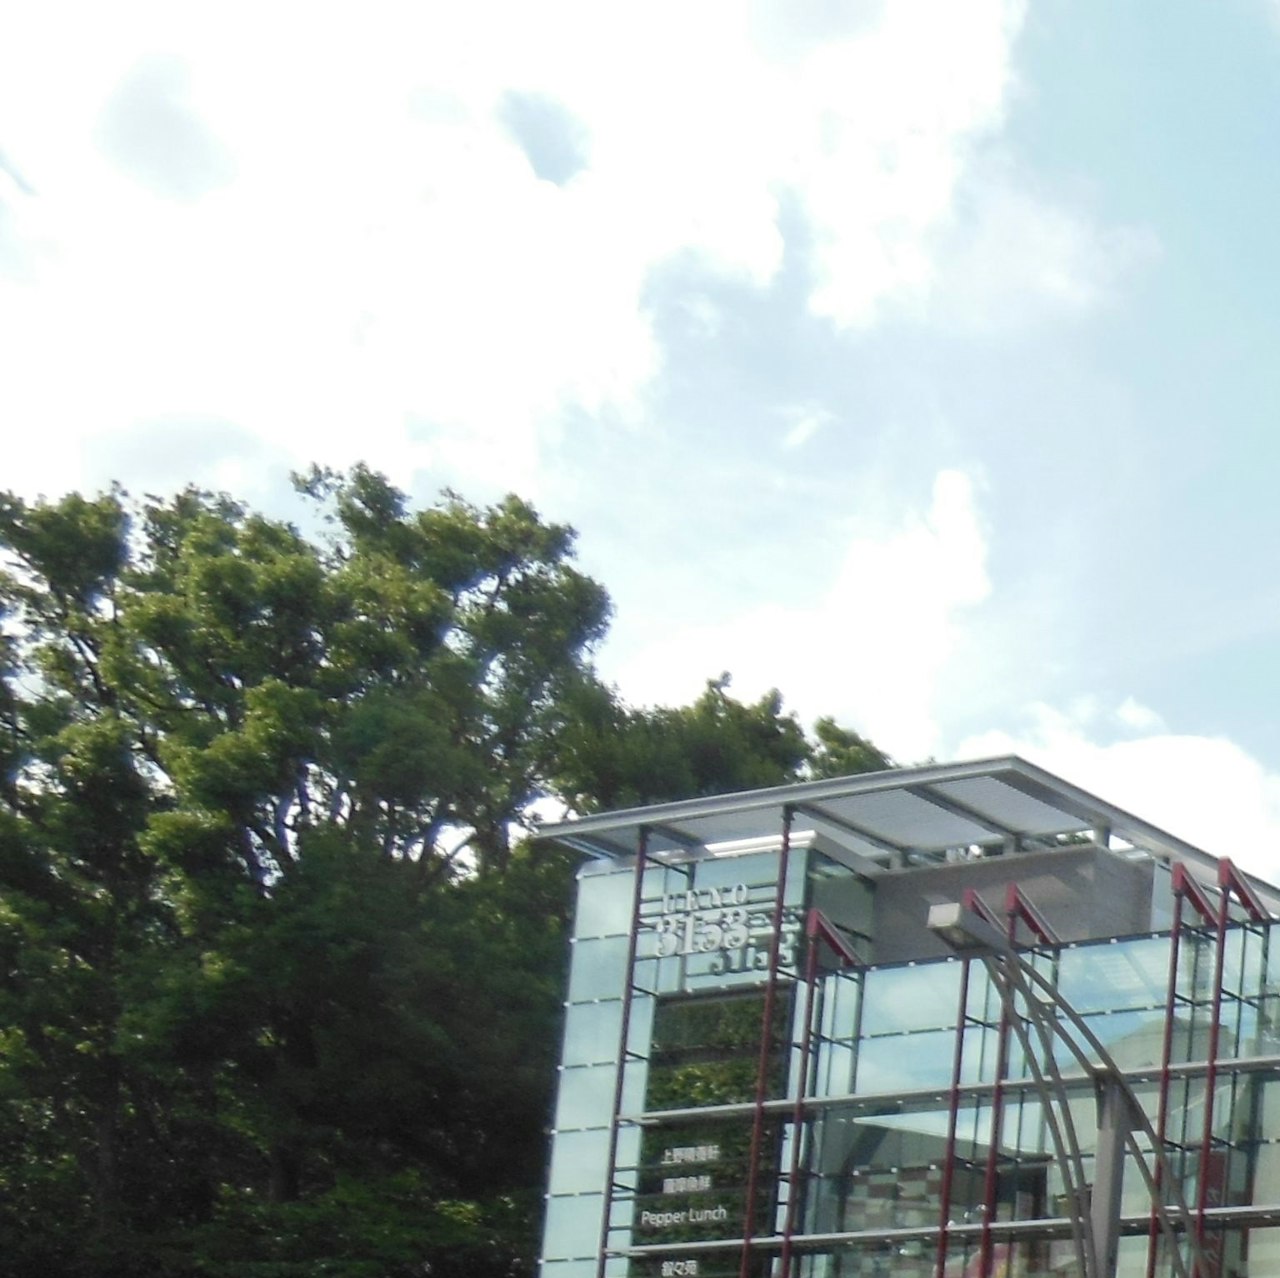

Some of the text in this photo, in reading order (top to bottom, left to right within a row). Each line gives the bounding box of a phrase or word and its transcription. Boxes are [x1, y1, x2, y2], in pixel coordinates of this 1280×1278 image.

[656, 908, 749, 957] 3153
[641, 1203, 727, 1228] Pepper Lunch
